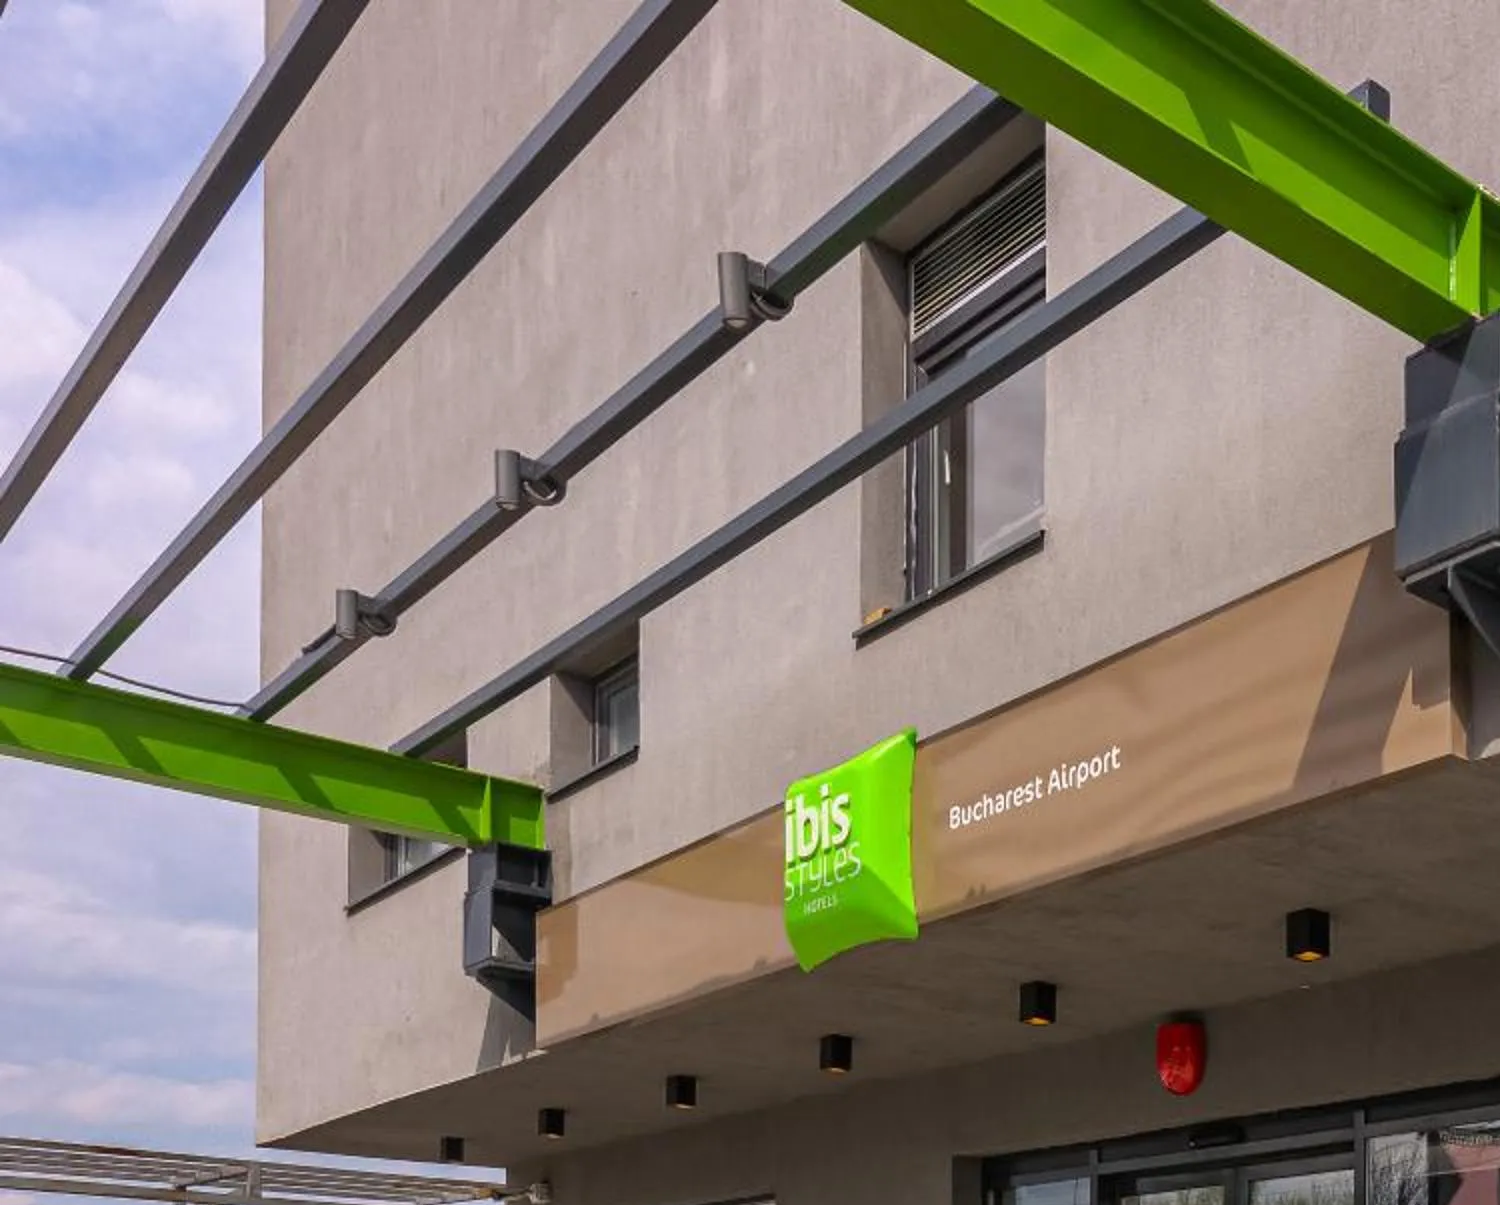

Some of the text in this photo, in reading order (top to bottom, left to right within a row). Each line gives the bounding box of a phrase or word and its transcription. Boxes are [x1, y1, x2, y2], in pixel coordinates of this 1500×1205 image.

[785, 784, 851, 862] ibis
[949, 745, 1121, 829] Bucharest Airport
